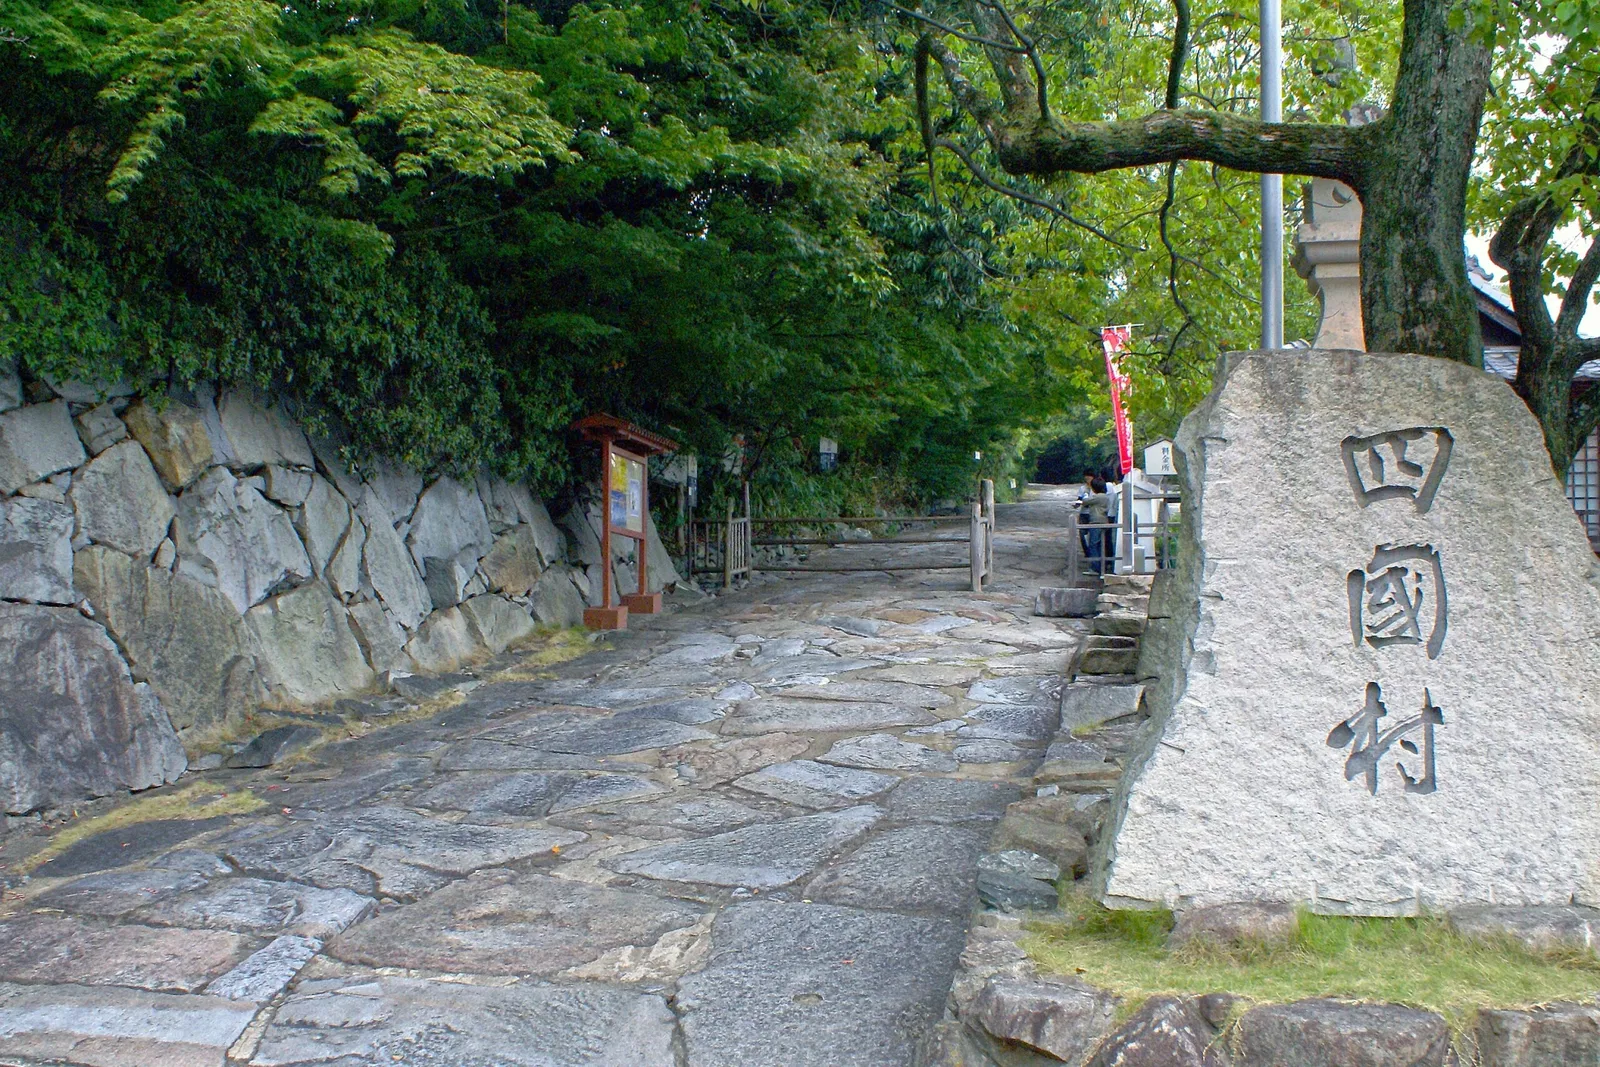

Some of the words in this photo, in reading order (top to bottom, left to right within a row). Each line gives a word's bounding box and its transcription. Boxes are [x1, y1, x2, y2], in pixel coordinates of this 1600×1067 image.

[1161, 447, 1170, 472] 料金所
[1326, 426, 1454, 796] 四國村
